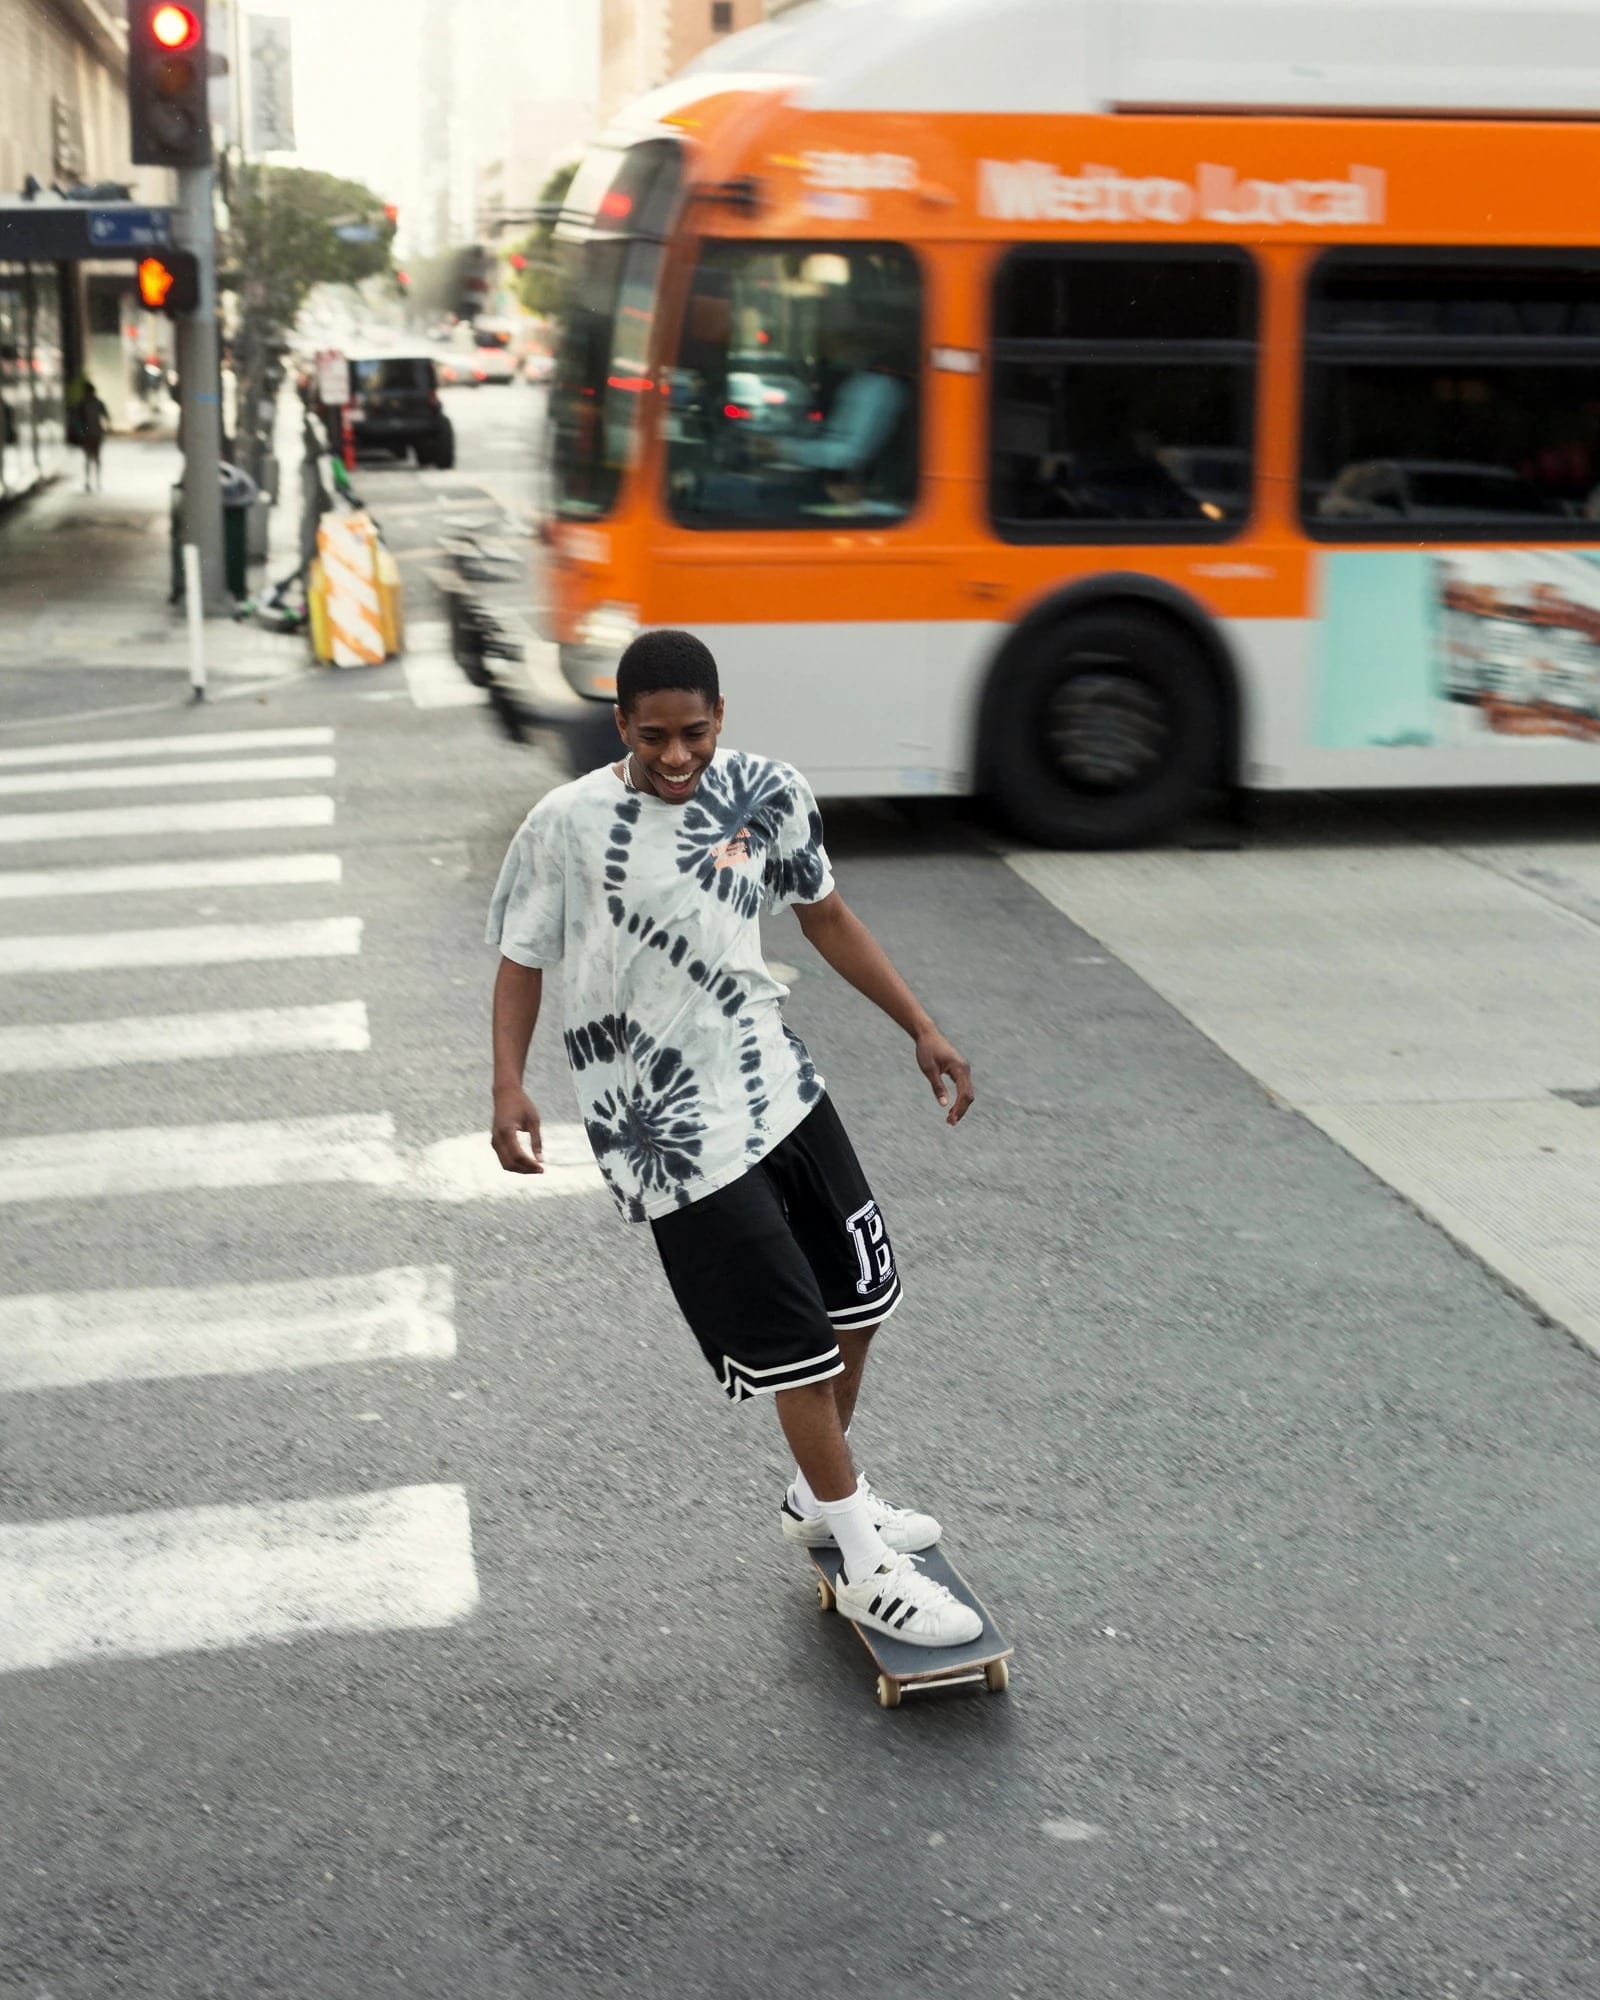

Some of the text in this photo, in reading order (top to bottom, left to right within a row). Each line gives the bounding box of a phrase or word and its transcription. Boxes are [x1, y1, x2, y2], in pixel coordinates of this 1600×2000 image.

[977, 158, 1196, 223] Metro
[1197, 162, 1388, 225] Local
[846, 1200, 897, 1294] B
